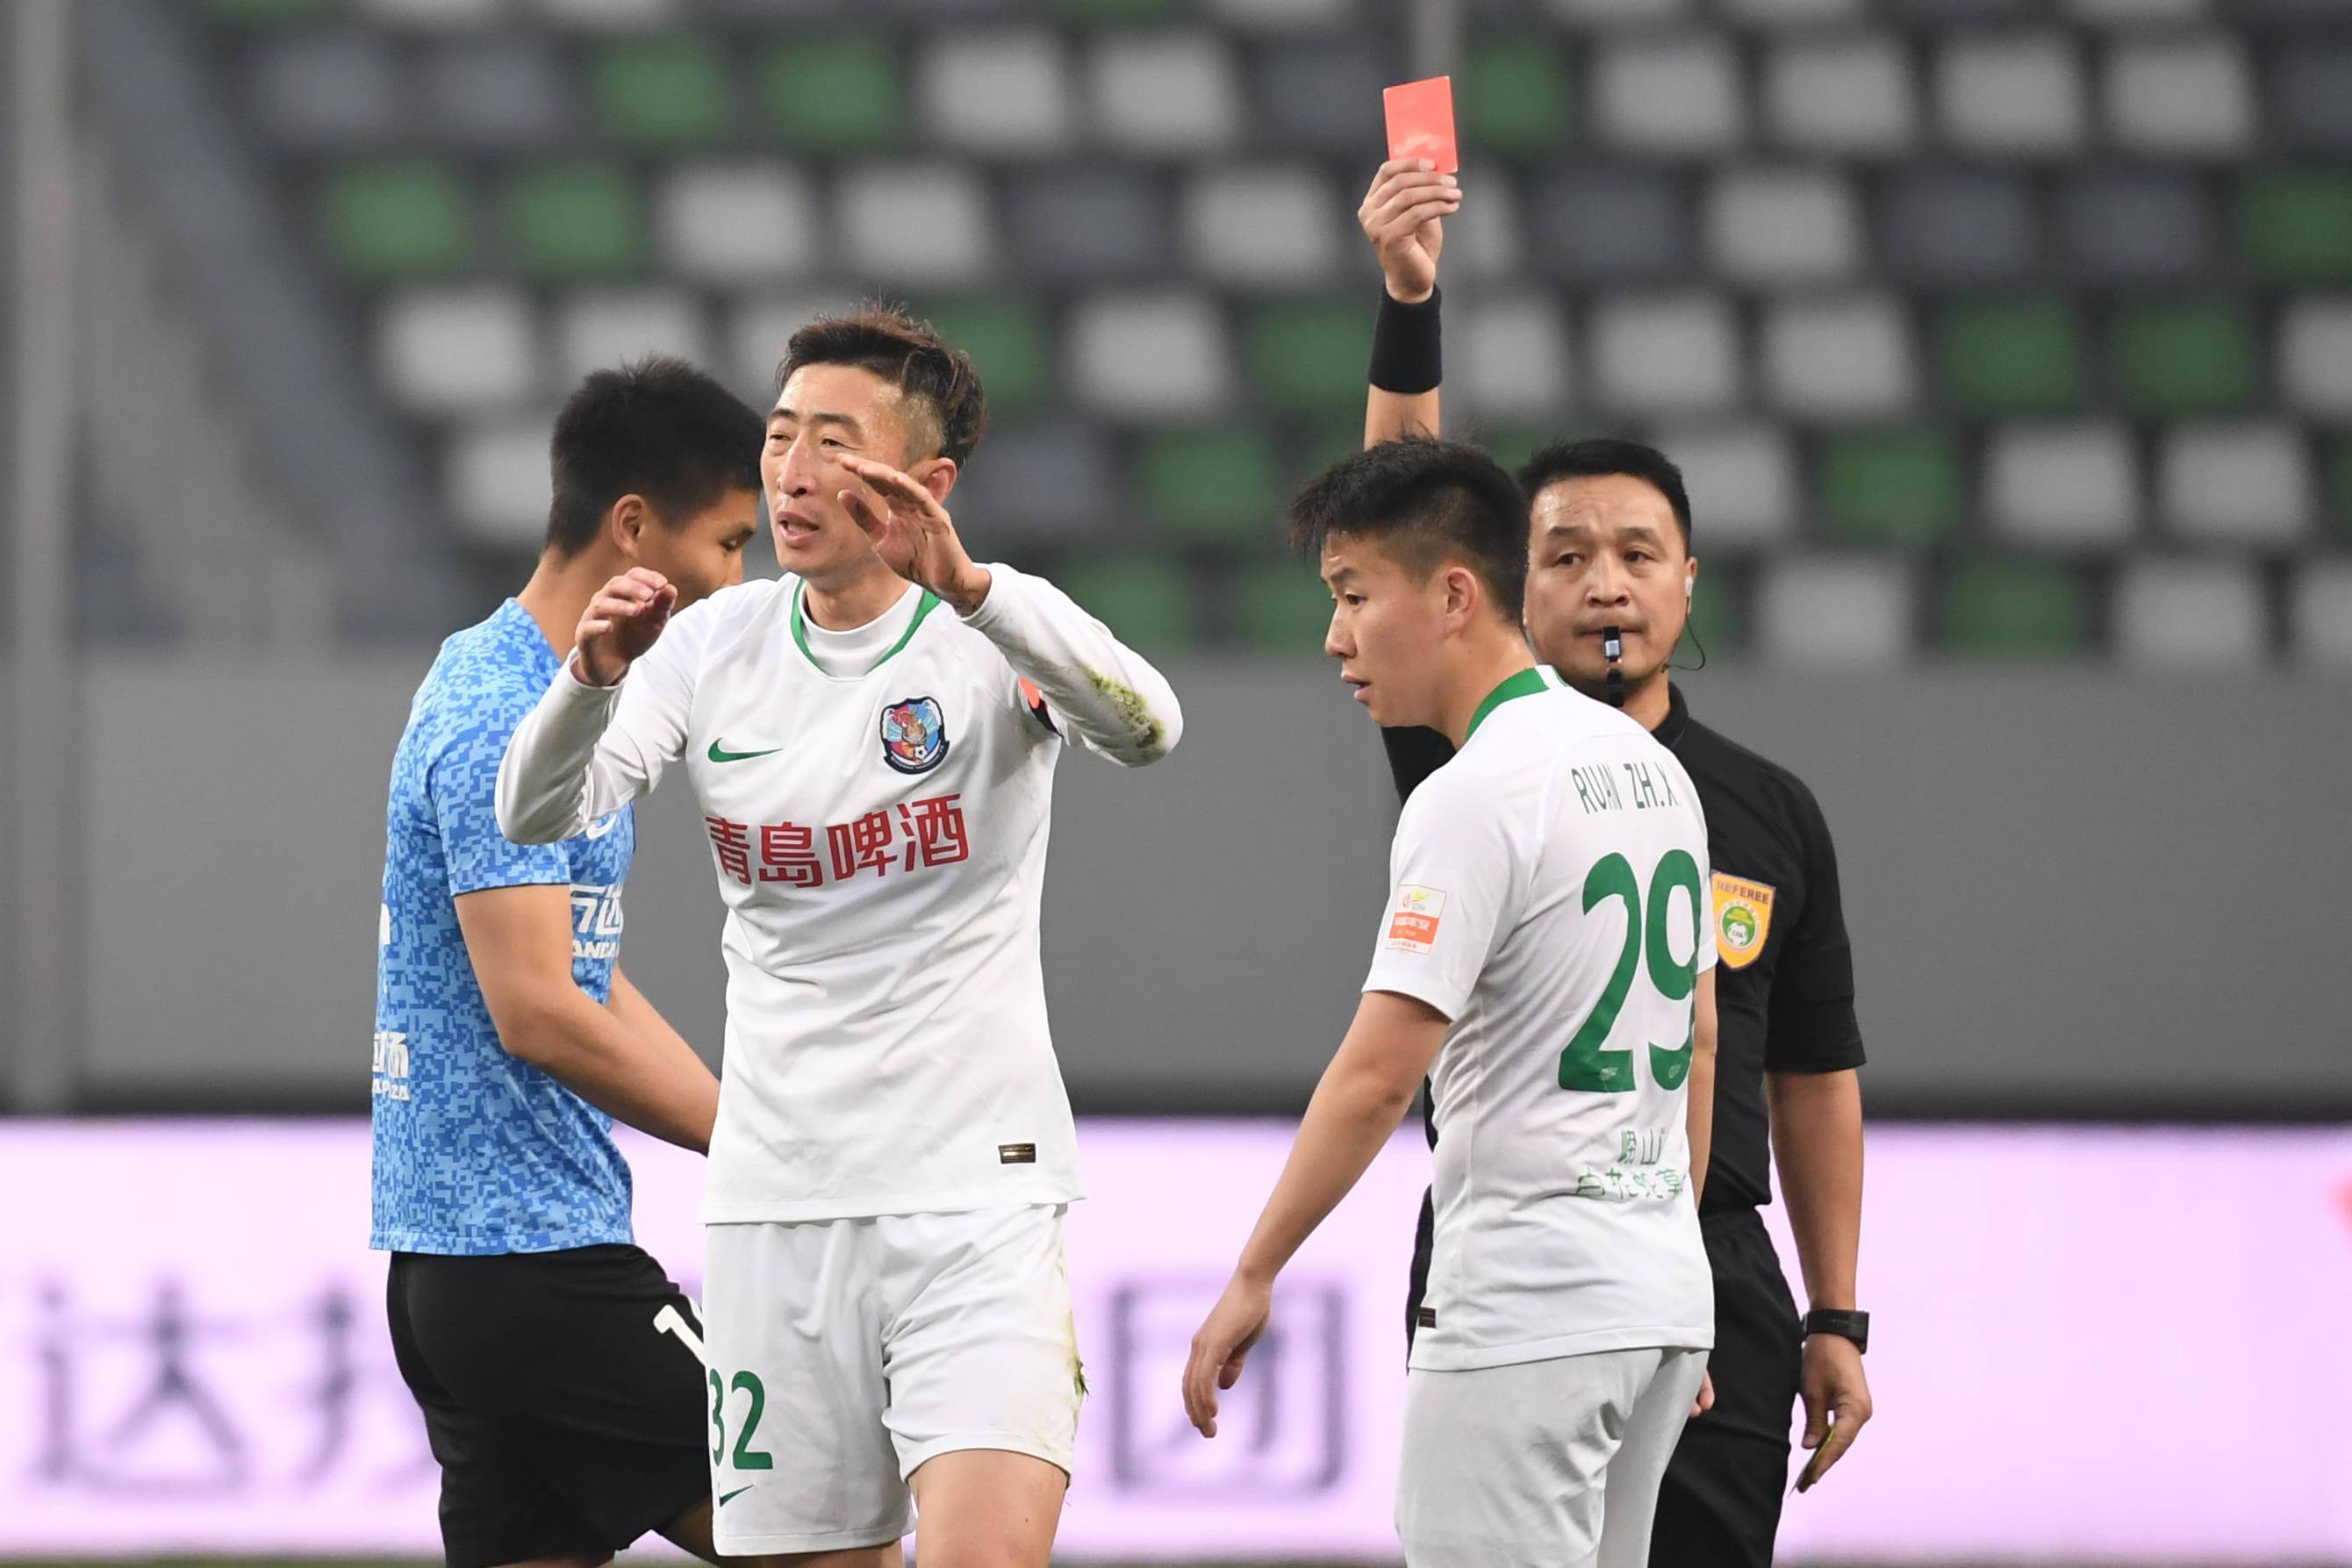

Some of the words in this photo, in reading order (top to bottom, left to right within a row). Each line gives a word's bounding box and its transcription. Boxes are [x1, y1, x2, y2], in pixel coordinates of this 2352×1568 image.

[1717, 880, 1770, 906] REFEREE
[1559, 849, 1701, 1092] 29
[709, 1367, 774, 1471] 32
